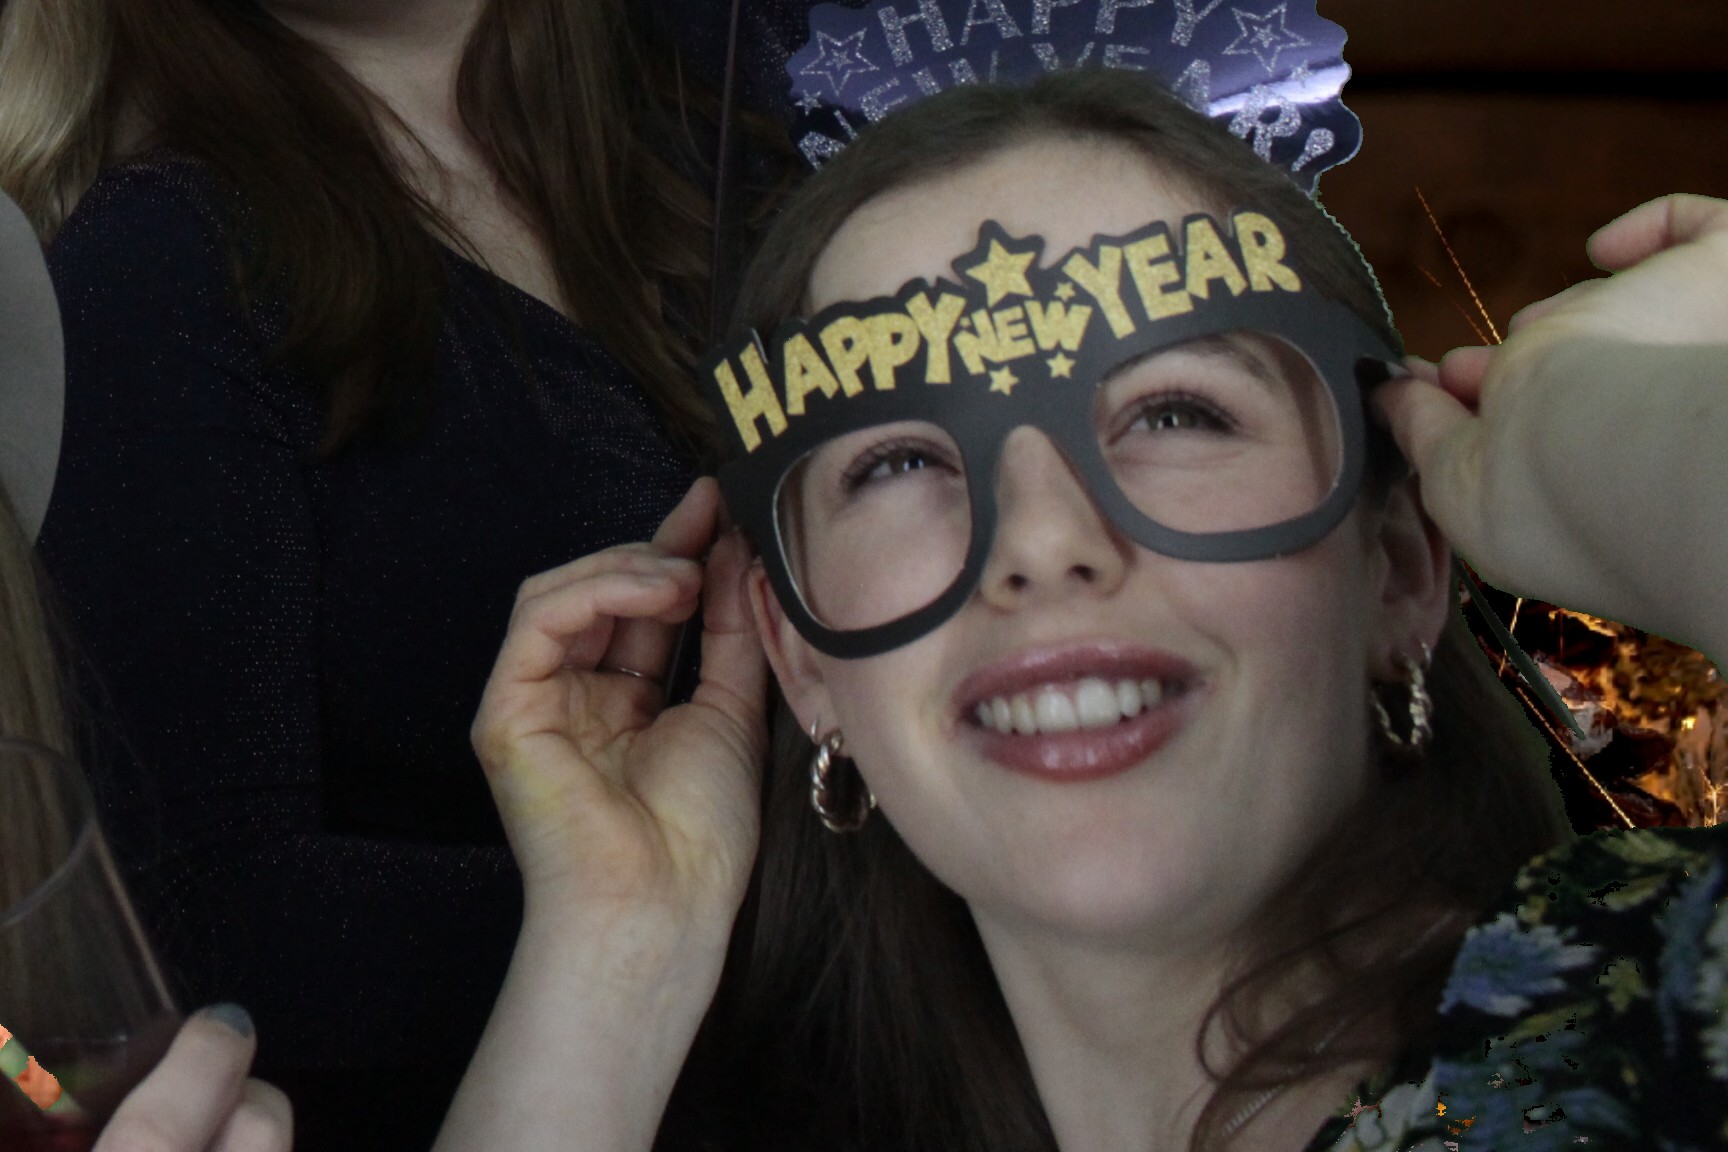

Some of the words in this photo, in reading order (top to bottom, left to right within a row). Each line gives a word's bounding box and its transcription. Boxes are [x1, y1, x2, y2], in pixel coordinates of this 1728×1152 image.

[713, 291, 965, 453] HAPPY
[953, 300, 1093, 374] NEW
[1062, 211, 1301, 340] YEAR
